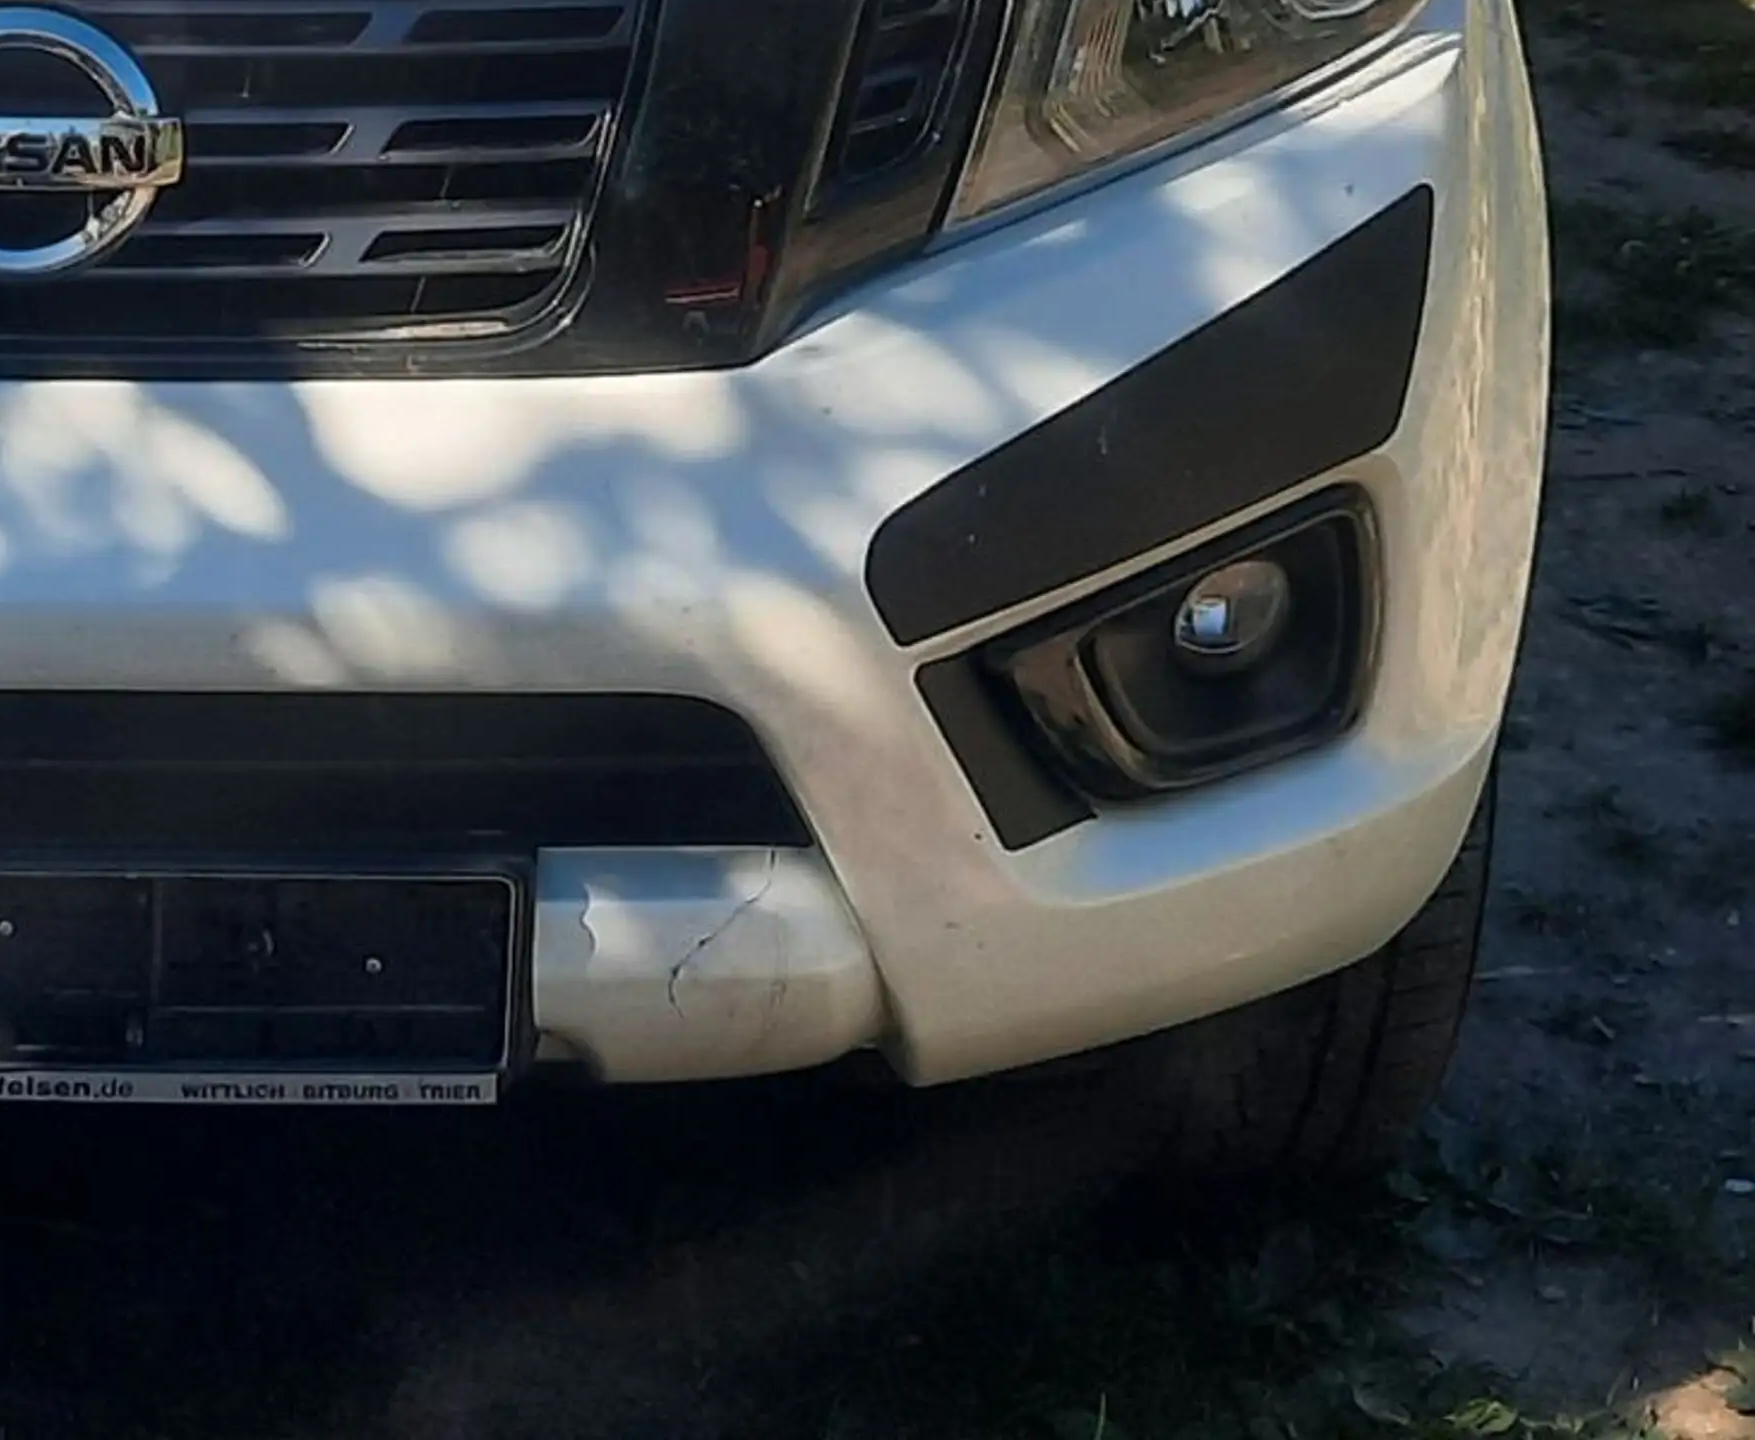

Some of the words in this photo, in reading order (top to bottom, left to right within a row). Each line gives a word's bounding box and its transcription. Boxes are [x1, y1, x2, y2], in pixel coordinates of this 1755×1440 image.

[180, 1082, 286, 1099] WITTLICH
[302, 1083, 399, 1100] BITBURG
[419, 1083, 482, 1100] TRIER
